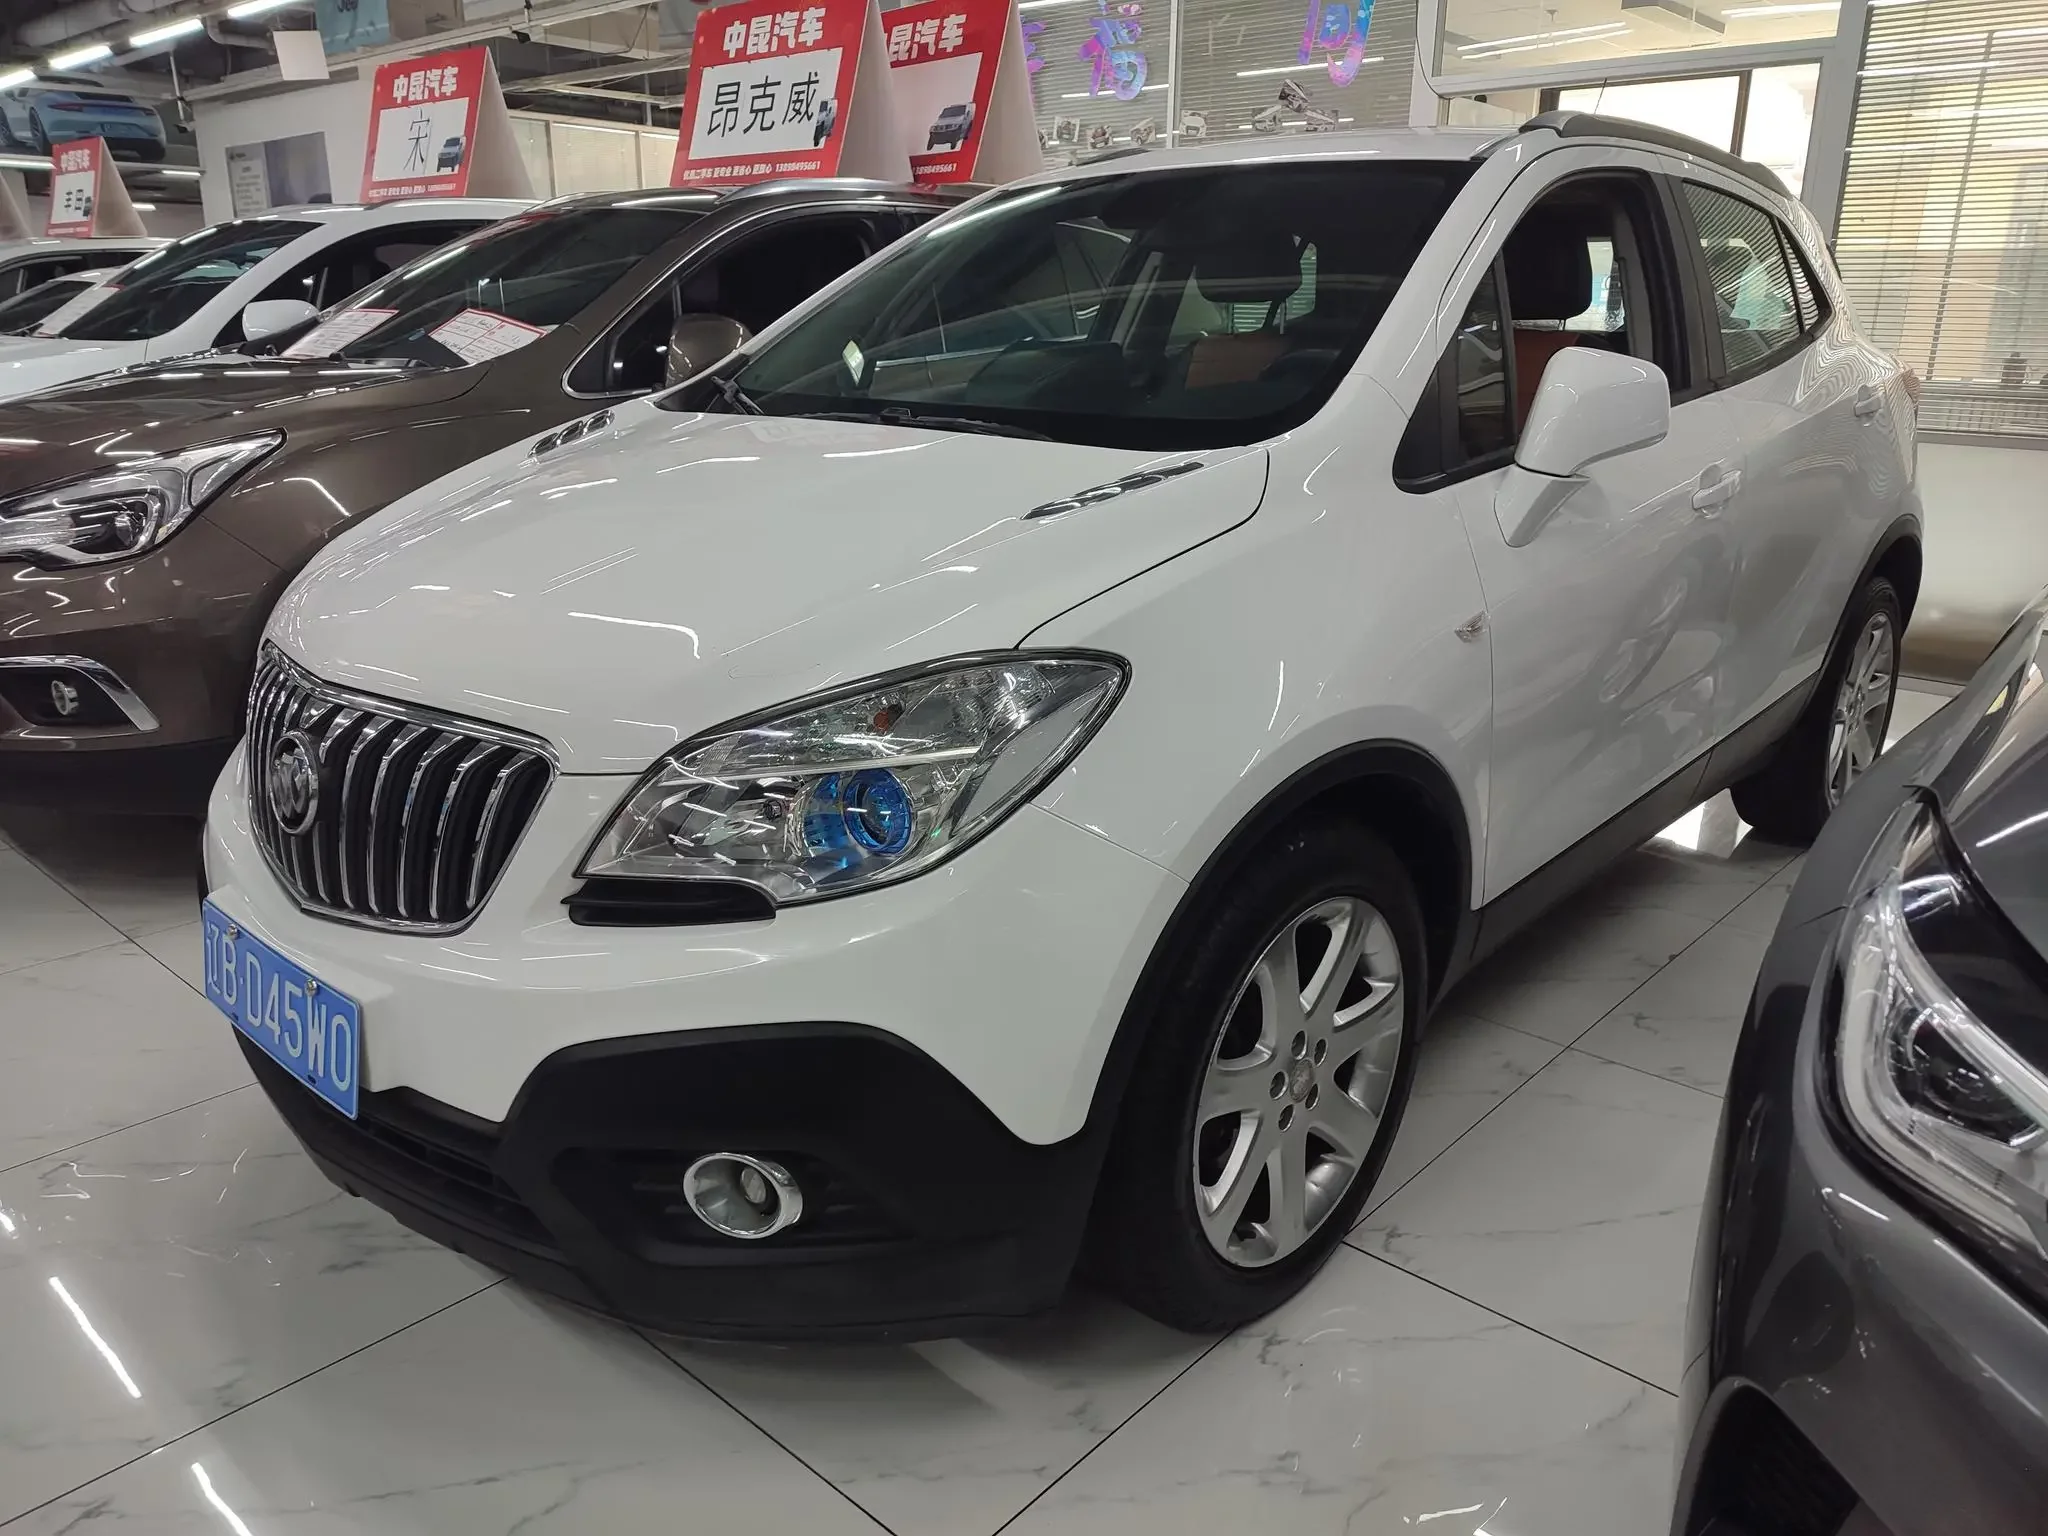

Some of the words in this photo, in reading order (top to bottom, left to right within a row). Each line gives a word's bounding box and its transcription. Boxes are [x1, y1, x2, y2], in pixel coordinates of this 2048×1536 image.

[723, 7, 827, 58] 中昆汽车
[886, 14, 968, 61] 昆汽车
[393, 66, 459, 103] 中昆汽车
[707, 72, 820, 138] 昂克威
[404, 106, 431, 171] 宋
